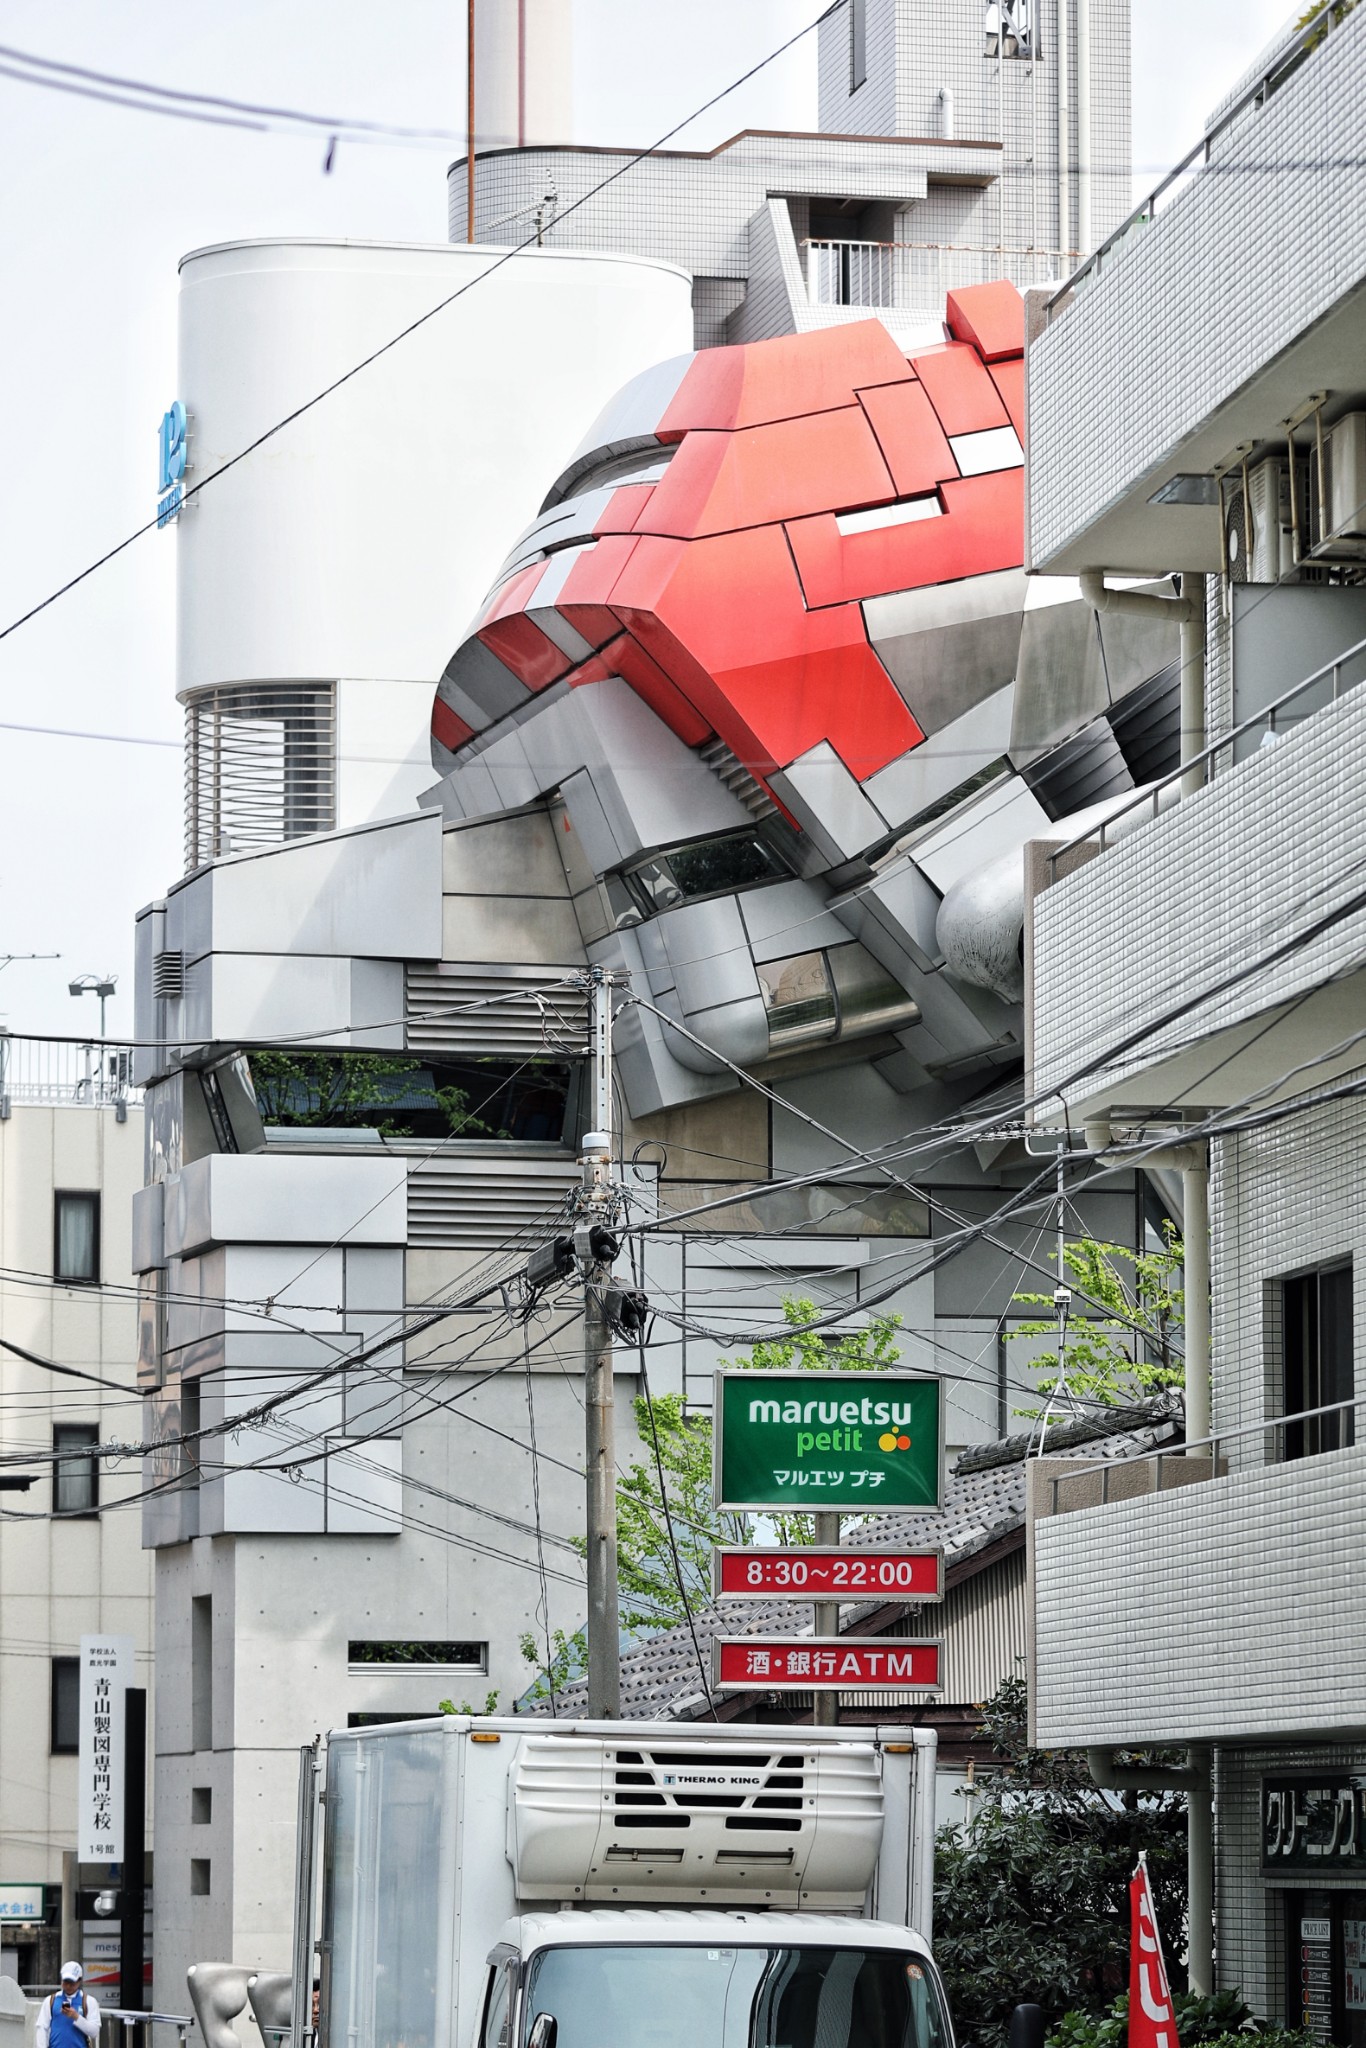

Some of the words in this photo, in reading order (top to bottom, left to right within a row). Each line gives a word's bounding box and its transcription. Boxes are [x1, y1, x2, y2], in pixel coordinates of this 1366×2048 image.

[748, 1397, 912, 1425] maruetsu
[797, 1426, 863, 1458] petit
[773, 1470, 844, 1487] マルエツ
[850, 1470, 886, 1488] プチ
[746, 1560, 913, 1586] 8:30～22:00
[89, 1648, 117, 1656] 学校法人
[745, 1651, 913, 1677] 酒・銀行ATM
[92, 1677, 112, 1831] 青山製図専門学校
[678, 1776, 726, 1784] THERMO
[89, 1844, 115, 1855] 1号館
